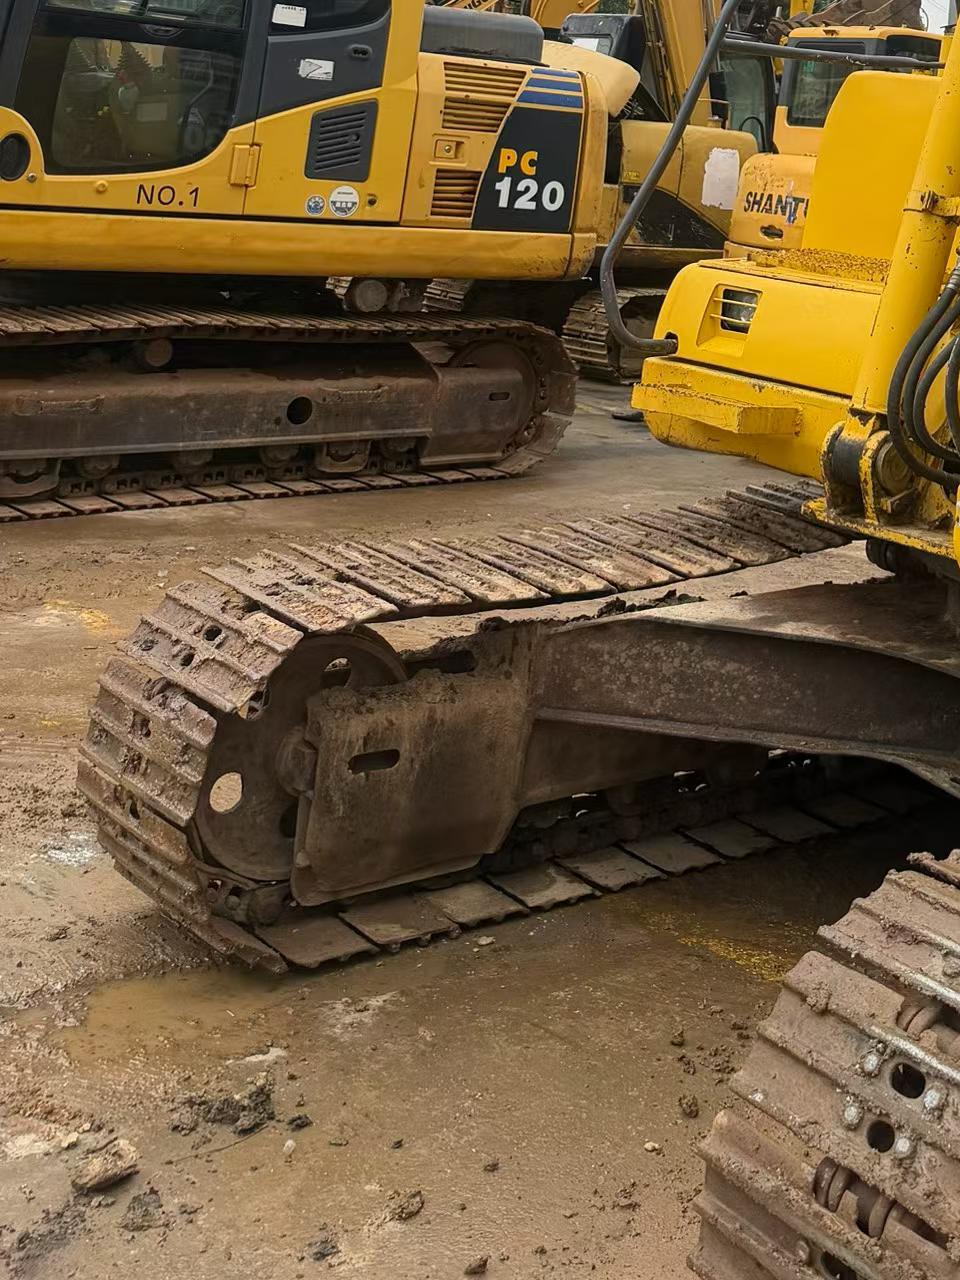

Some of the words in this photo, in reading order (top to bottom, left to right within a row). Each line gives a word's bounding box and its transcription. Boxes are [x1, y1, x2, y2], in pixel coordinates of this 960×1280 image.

[498, 148, 538, 176] PC
[136, 183, 200, 208] NO.1
[495, 176, 565, 212] 120
